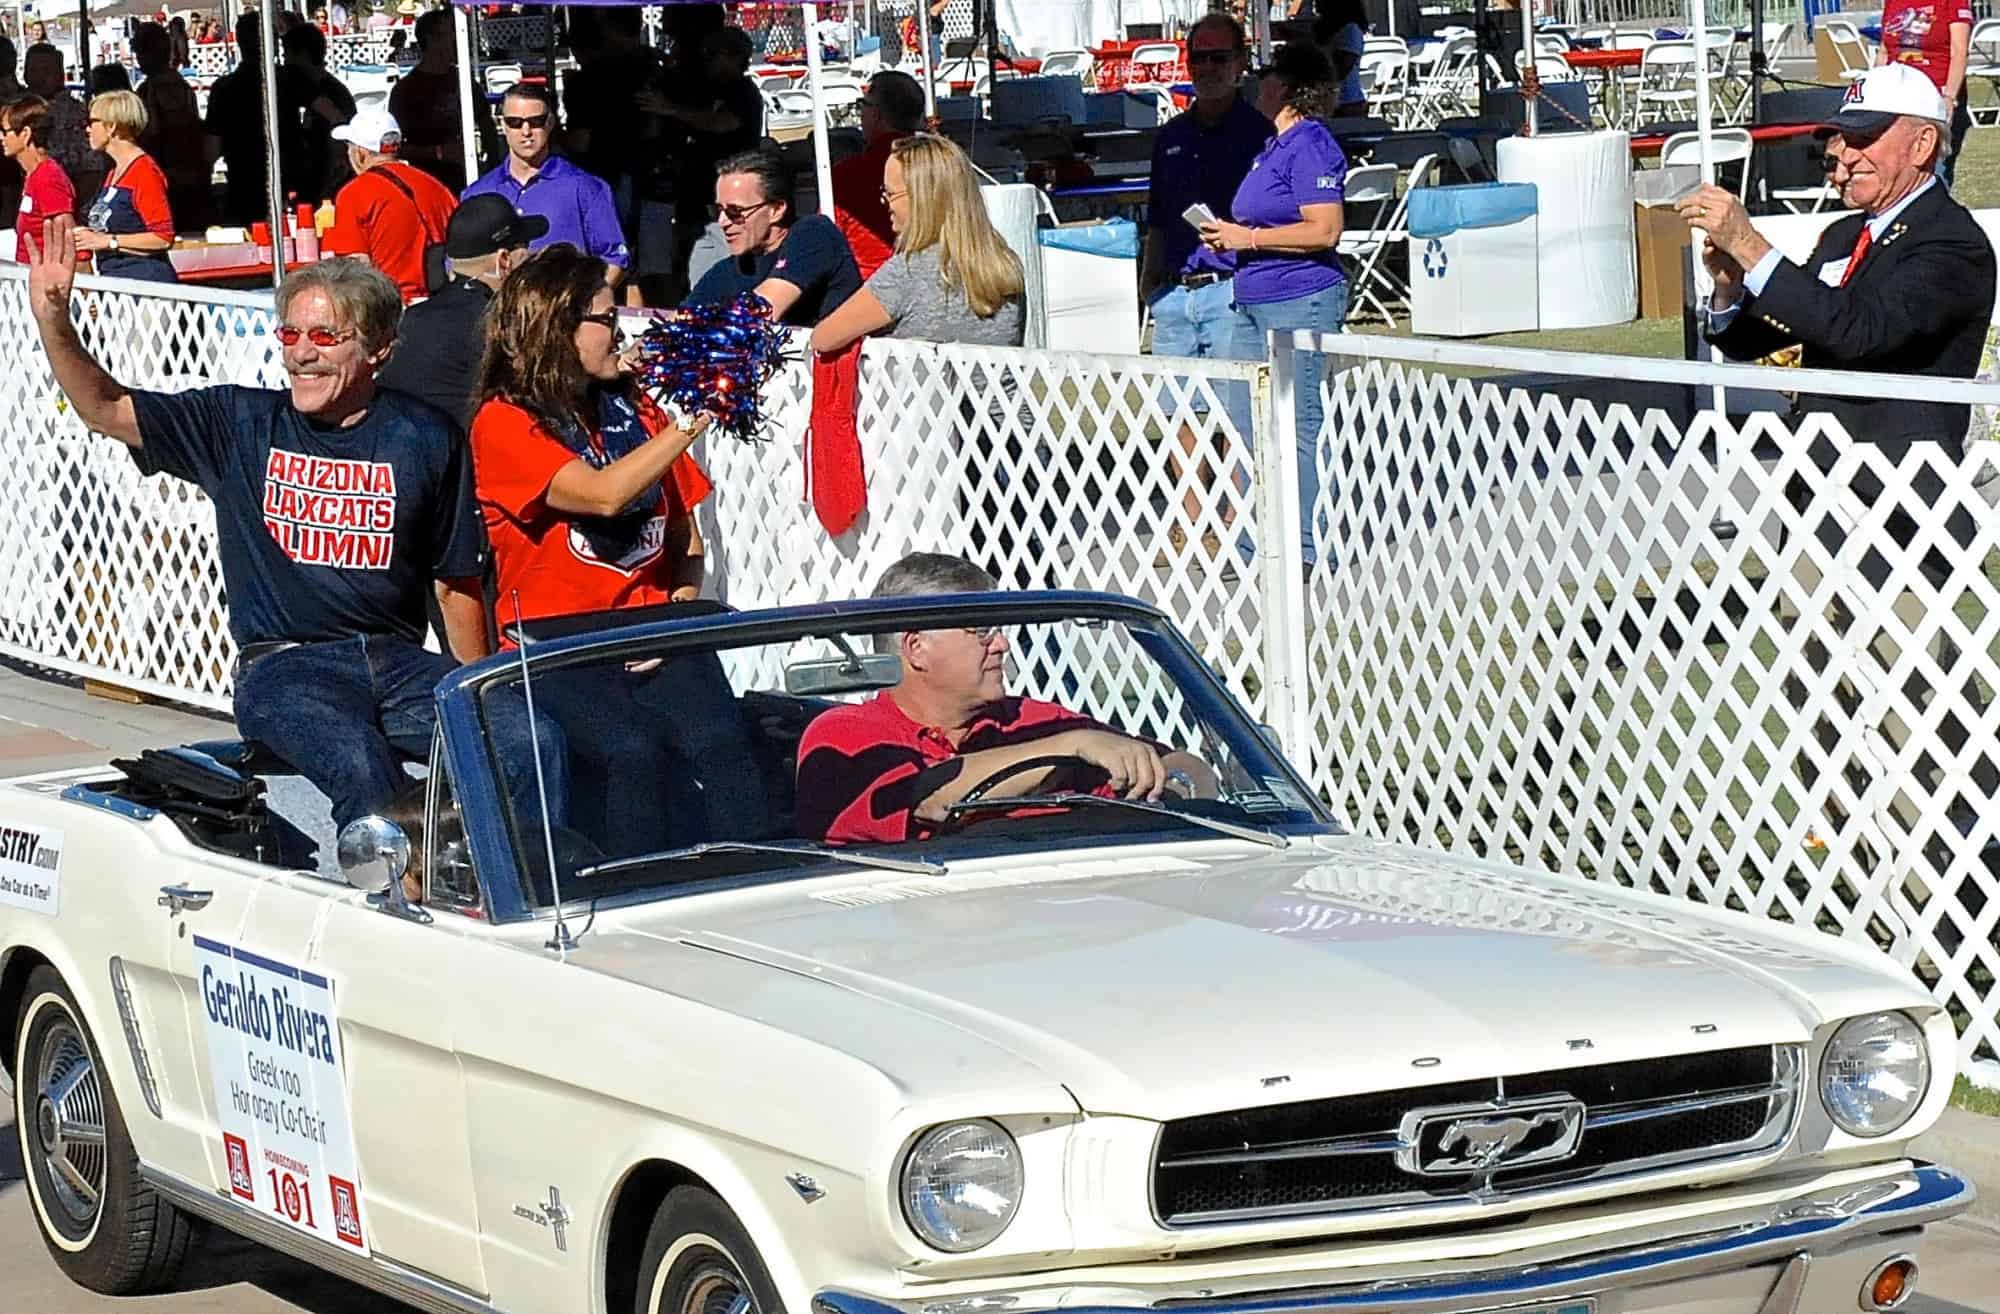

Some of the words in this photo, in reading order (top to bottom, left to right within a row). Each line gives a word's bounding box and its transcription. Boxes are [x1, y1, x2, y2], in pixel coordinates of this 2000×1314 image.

[266, 447, 396, 497] ARIZONA
[263, 481, 396, 532] LAXCATS
[203, 964, 272, 1042] Geraldo
[272, 985, 336, 1065] Rivera
[247, 1050, 281, 1090] Greek
[279, 1069, 301, 1098] 100
[280, 1099, 327, 1145] Co-Chair
[267, 1168, 318, 1229] 101
